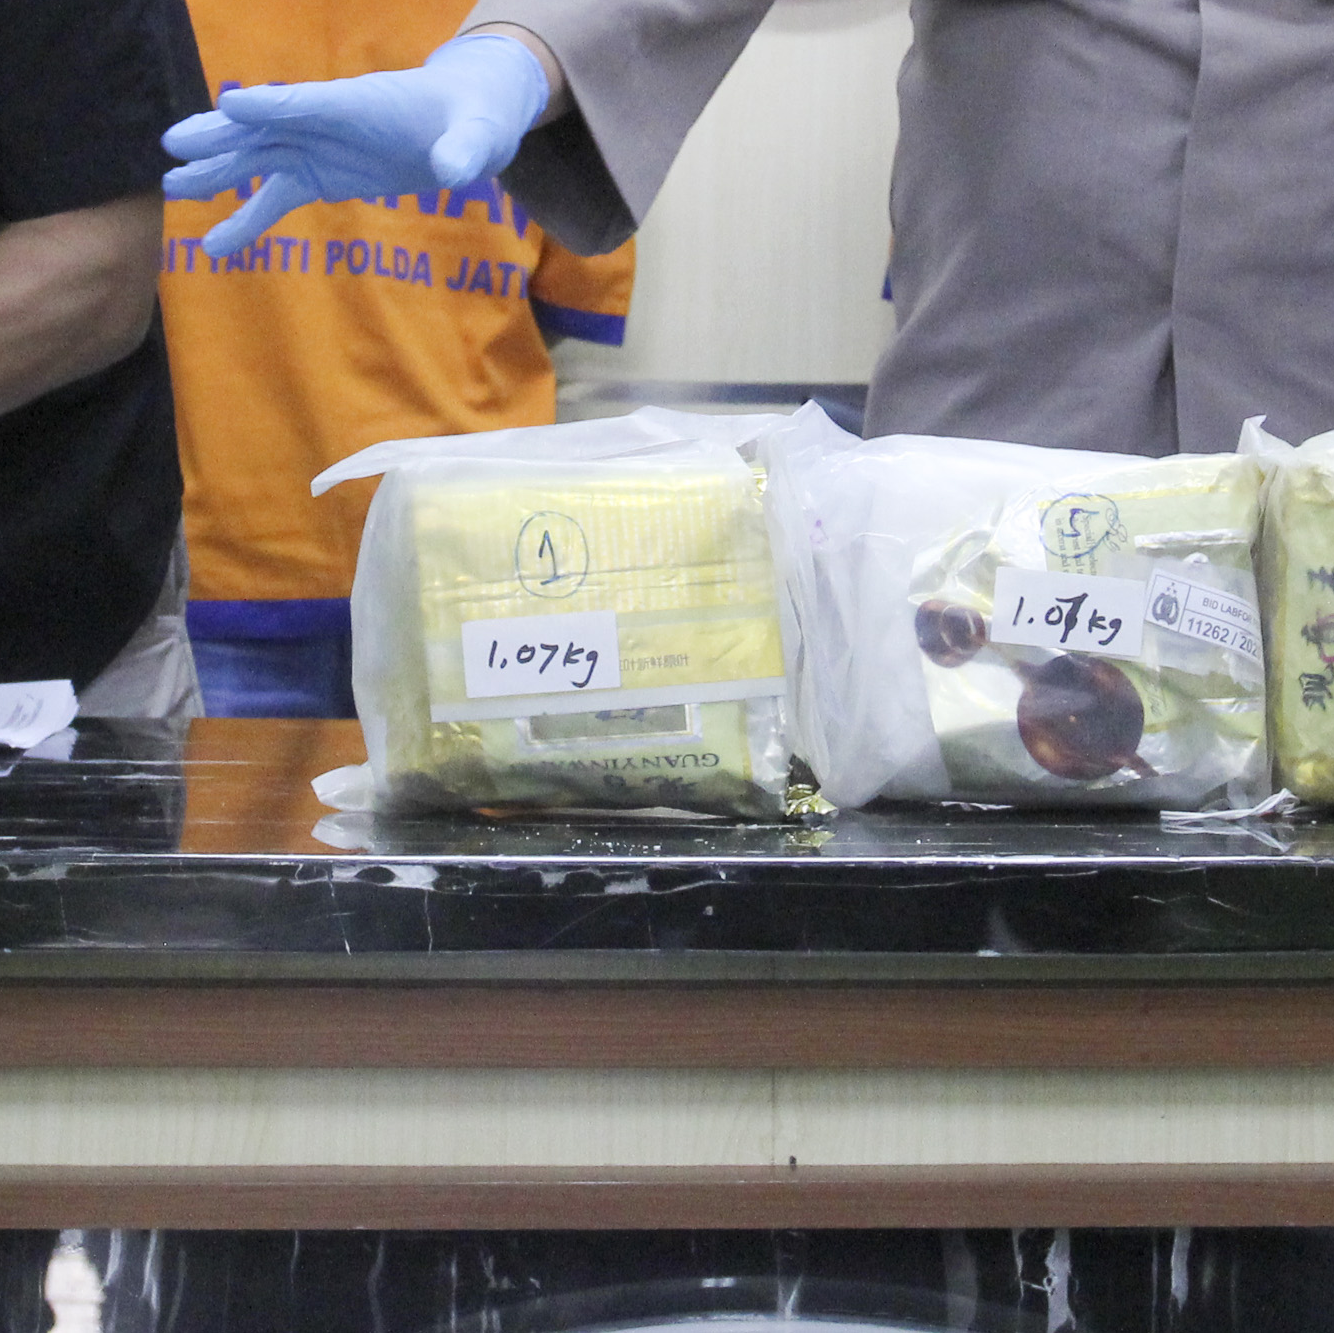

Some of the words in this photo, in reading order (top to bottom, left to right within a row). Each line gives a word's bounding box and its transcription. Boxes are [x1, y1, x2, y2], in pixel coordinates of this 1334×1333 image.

[324, 239, 433, 288] POLDA
[1202, 597, 1219, 613] BID
[1188, 617, 1230, 644] 11262
